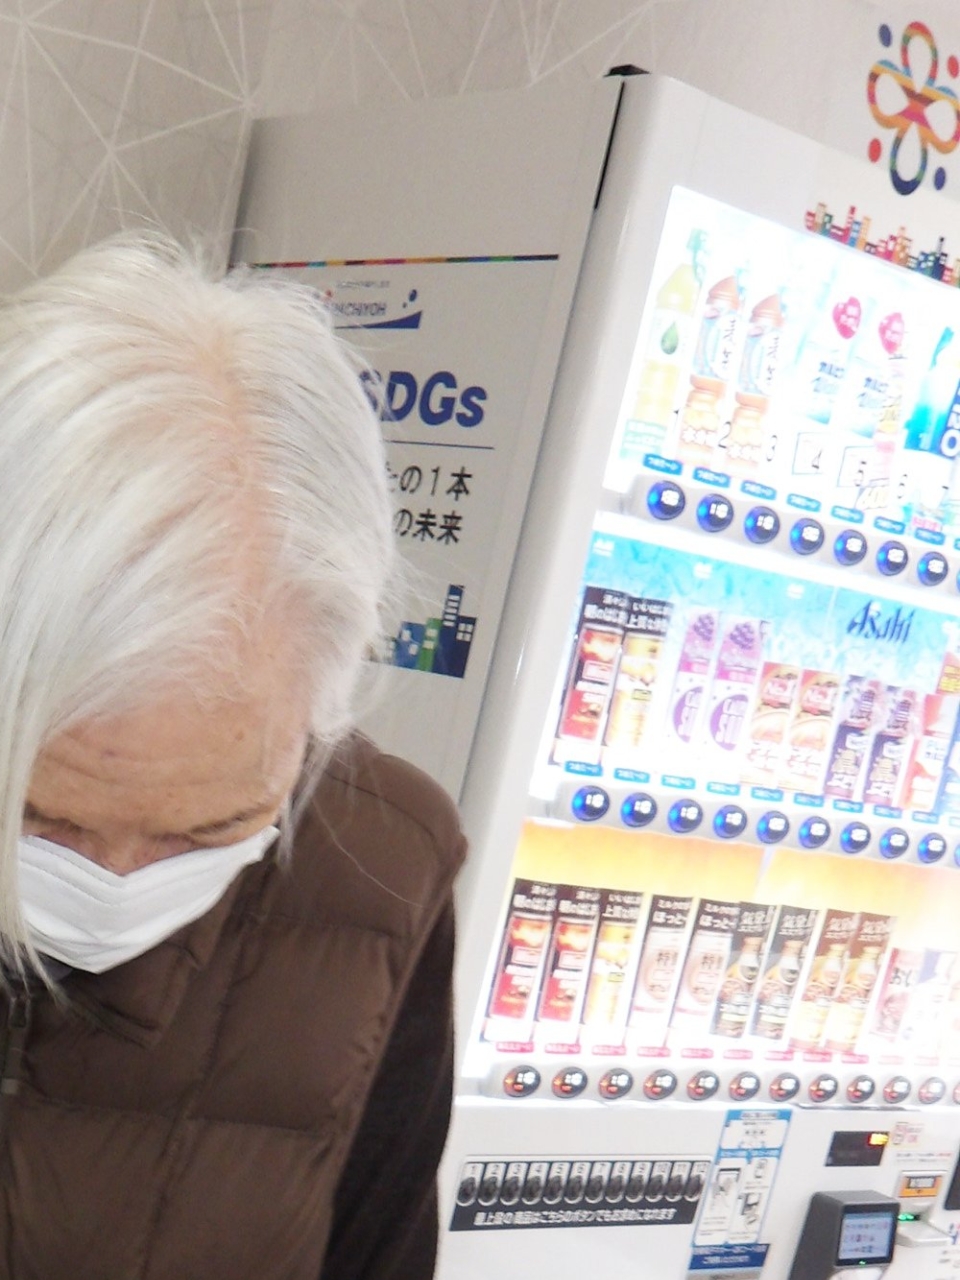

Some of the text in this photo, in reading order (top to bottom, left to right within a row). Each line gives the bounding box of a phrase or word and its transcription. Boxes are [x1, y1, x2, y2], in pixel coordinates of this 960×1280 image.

[717, 421, 732, 449] 2
[393, 507, 464, 546] の未来
[846, 599, 916, 644] Asahi
